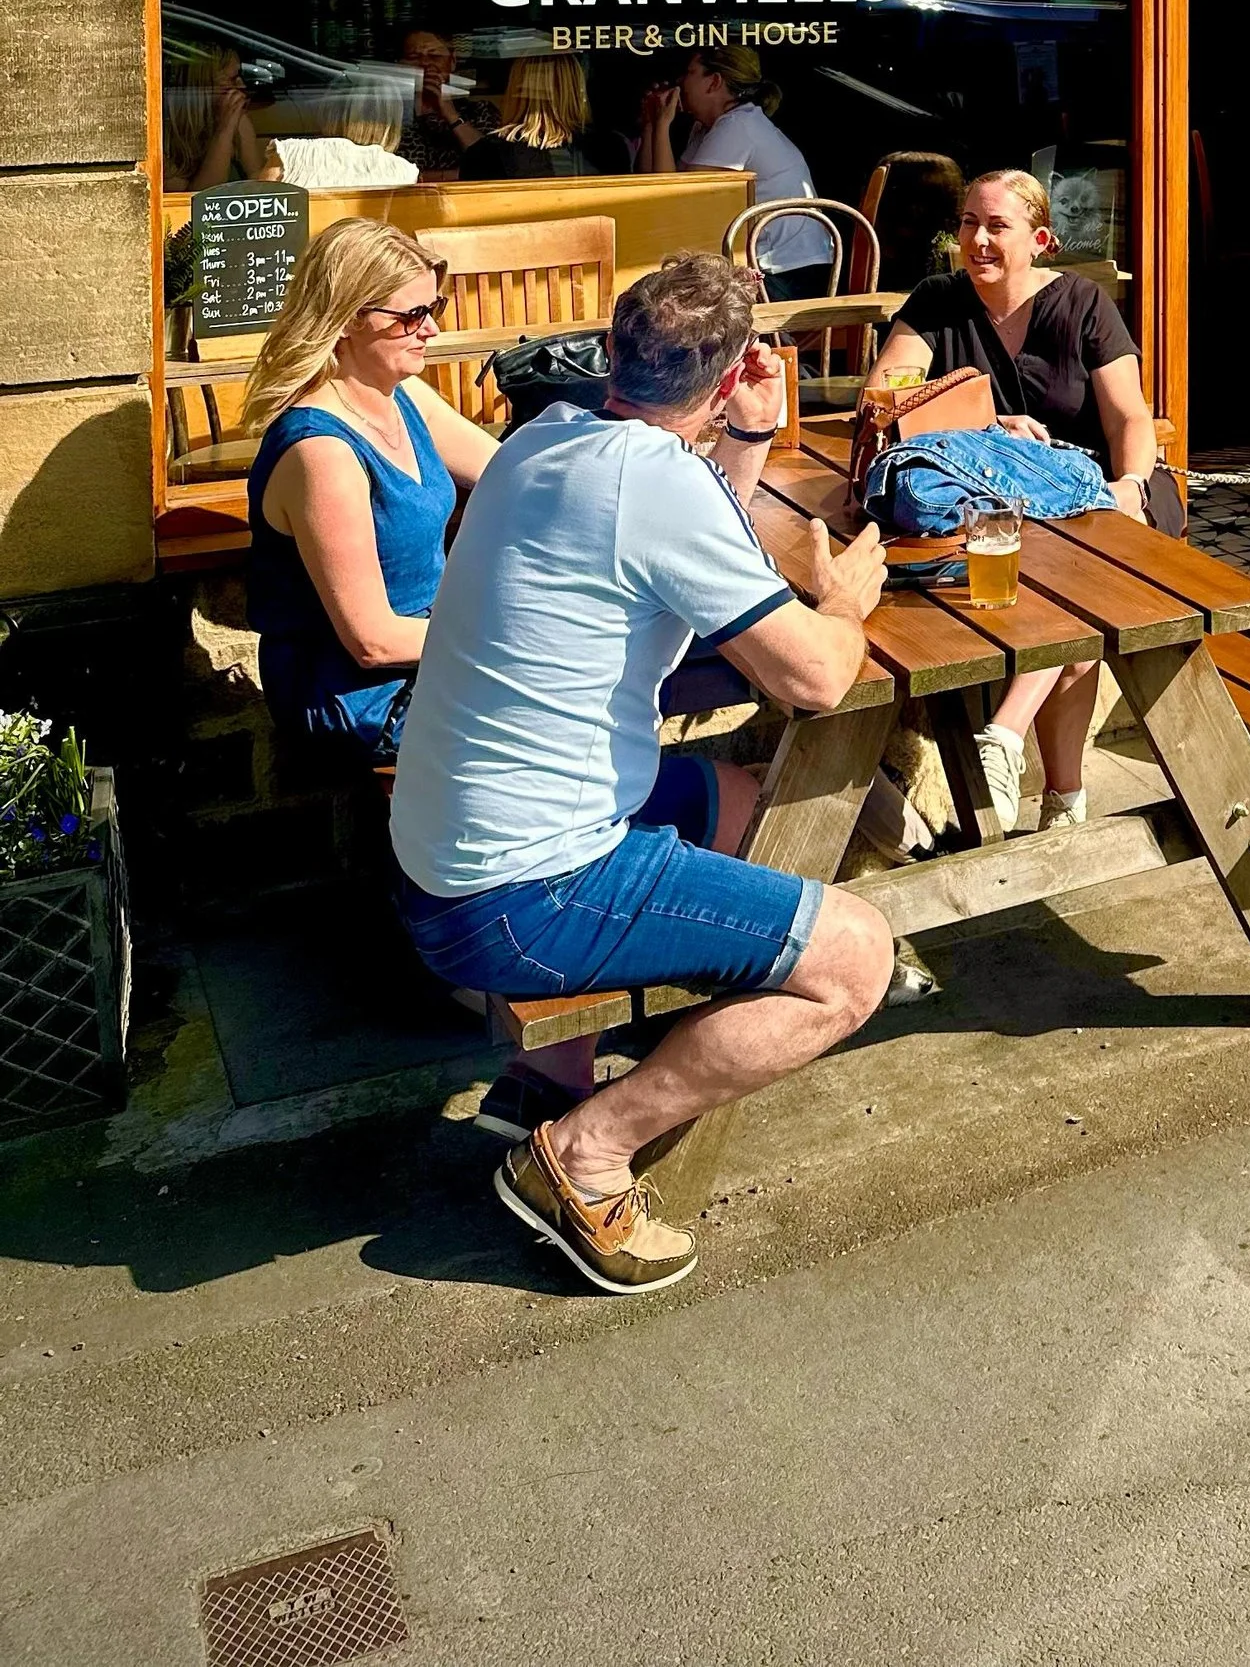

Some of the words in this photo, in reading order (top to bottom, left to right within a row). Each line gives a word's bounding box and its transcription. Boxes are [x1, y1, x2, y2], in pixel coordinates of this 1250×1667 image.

[553, 25, 653, 56] BEER
[644, 23, 664, 48] &
[675, 21, 725, 48] GIN
[741, 20, 838, 47] HOUSE
[246, 224, 285, 241] CLOSED
[1057, 234, 1111, 254] elcome!
[202, 290, 221, 304] Sat
[202, 307, 221, 319] Sun
